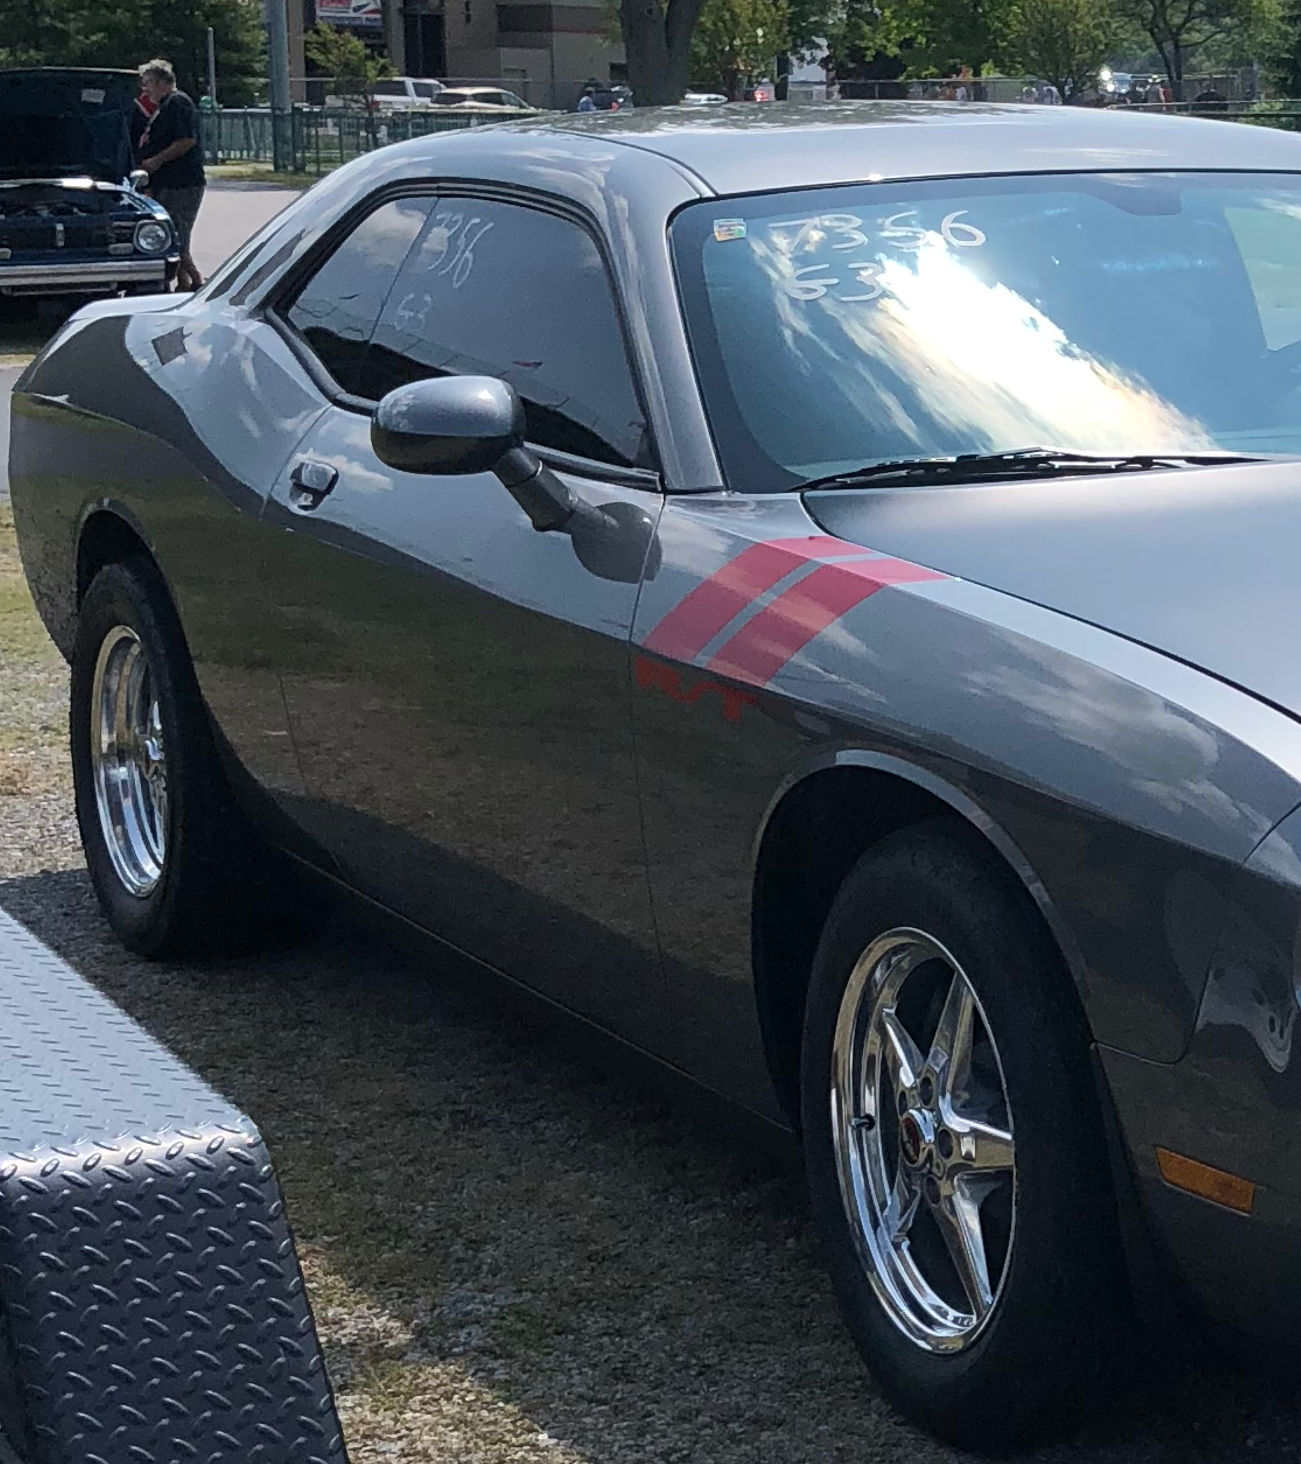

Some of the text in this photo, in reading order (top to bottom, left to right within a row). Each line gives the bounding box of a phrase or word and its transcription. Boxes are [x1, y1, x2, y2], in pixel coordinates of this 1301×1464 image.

[767, 209, 987, 251] 7356
[784, 262, 885, 301] 63
[635, 655, 758, 722] R/T
